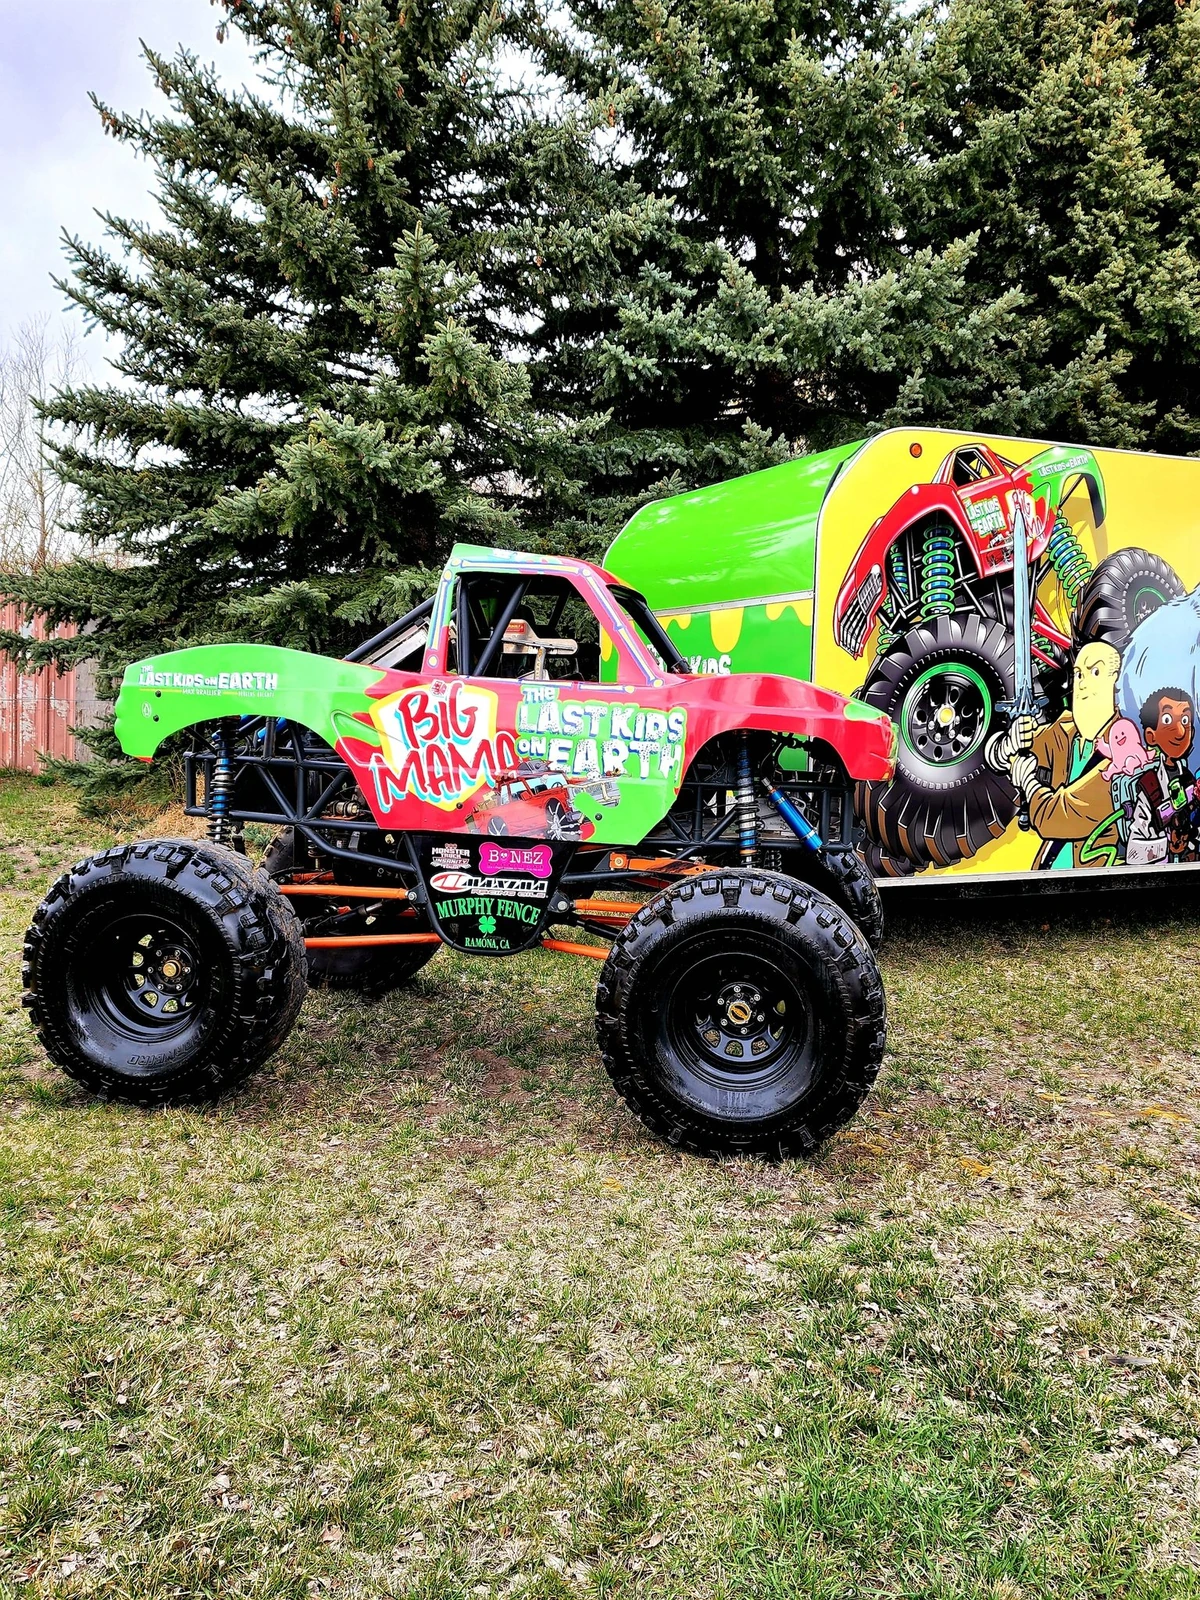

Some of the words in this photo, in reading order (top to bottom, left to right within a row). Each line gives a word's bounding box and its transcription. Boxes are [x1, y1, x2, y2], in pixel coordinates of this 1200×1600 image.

[978, 511, 1006, 537] EARTH
[138, 672, 172, 687] LAST
[172, 672, 204, 687] KIDS
[217, 672, 278, 690] EARTH
[518, 701, 608, 738] LAST
[610, 706, 685, 744] KIDS
[370, 732, 521, 813] MAMA
[517, 736, 548, 757] ON
[547, 737, 683, 783] EARTH
[431, 847, 471, 857] MONSTER
[435, 897, 495, 920] MURPHY
[495, 898, 542, 926] FENCE
[464, 937, 499, 950] RAMONA,
[500, 939, 511, 949] CA
